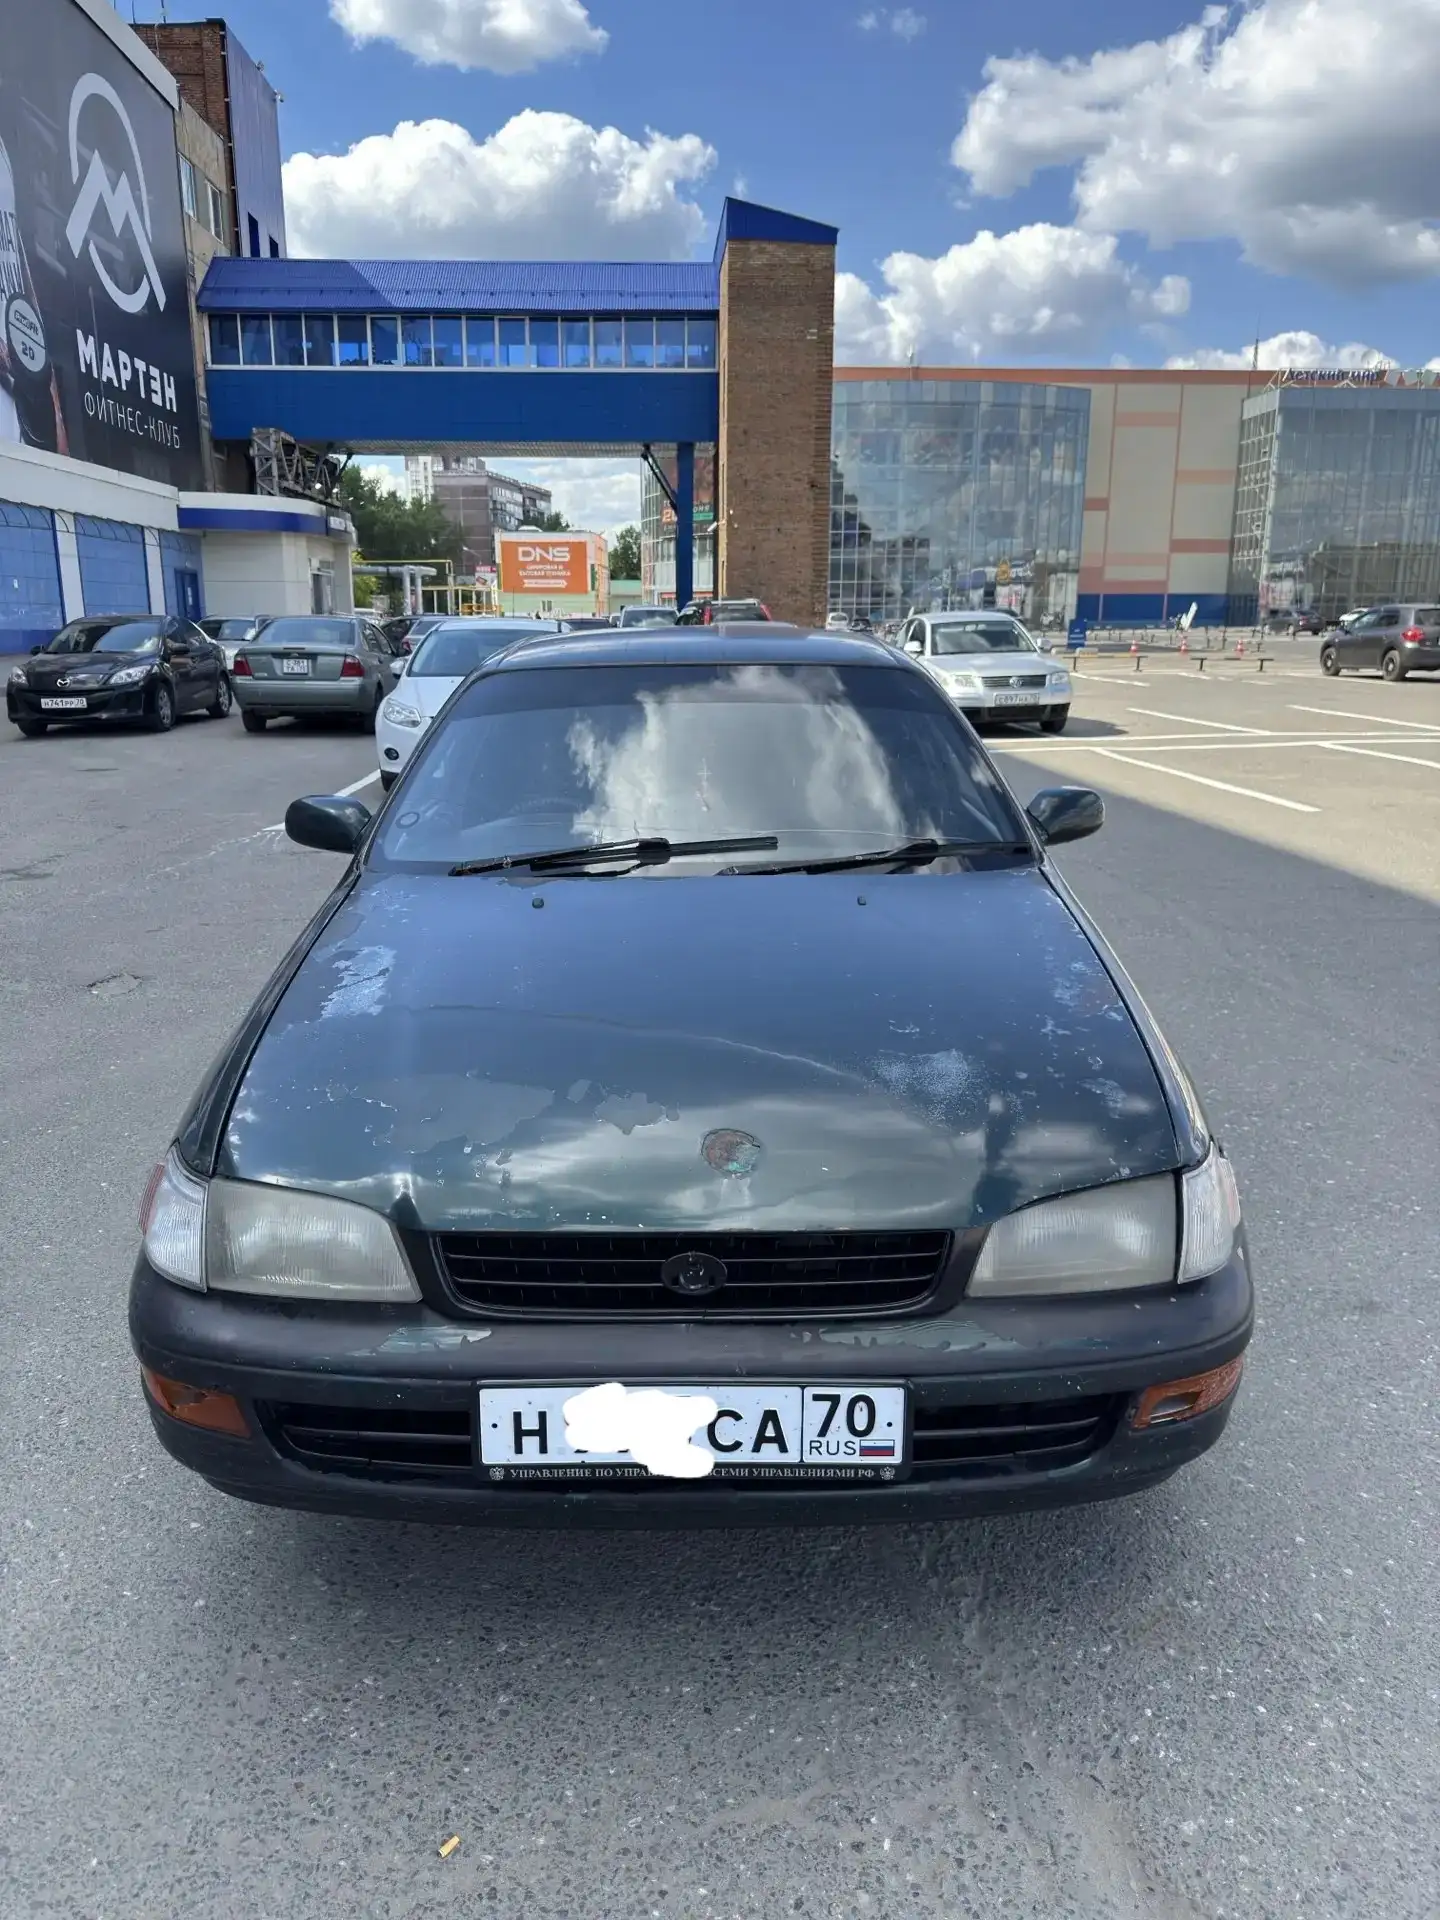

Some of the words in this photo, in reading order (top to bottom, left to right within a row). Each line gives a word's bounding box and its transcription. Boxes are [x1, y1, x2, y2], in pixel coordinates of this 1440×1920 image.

[76, 328, 177, 413] МАРТЭН
[84, 391, 180, 449] ФИТНЕС-КЛУБ
[518, 546, 570, 561] DNS
[811, 1394, 876, 1438] 70
[808, 1440, 856, 1456] RUS
[510, 1468, 592, 1478] УПРАВЛЕНИЕ
[595, 1468, 613, 1477] ПО
[751, 1468, 854, 1478] УПРАВЛЕНИЯМИ
[857, 1468, 875, 1478] РФ
